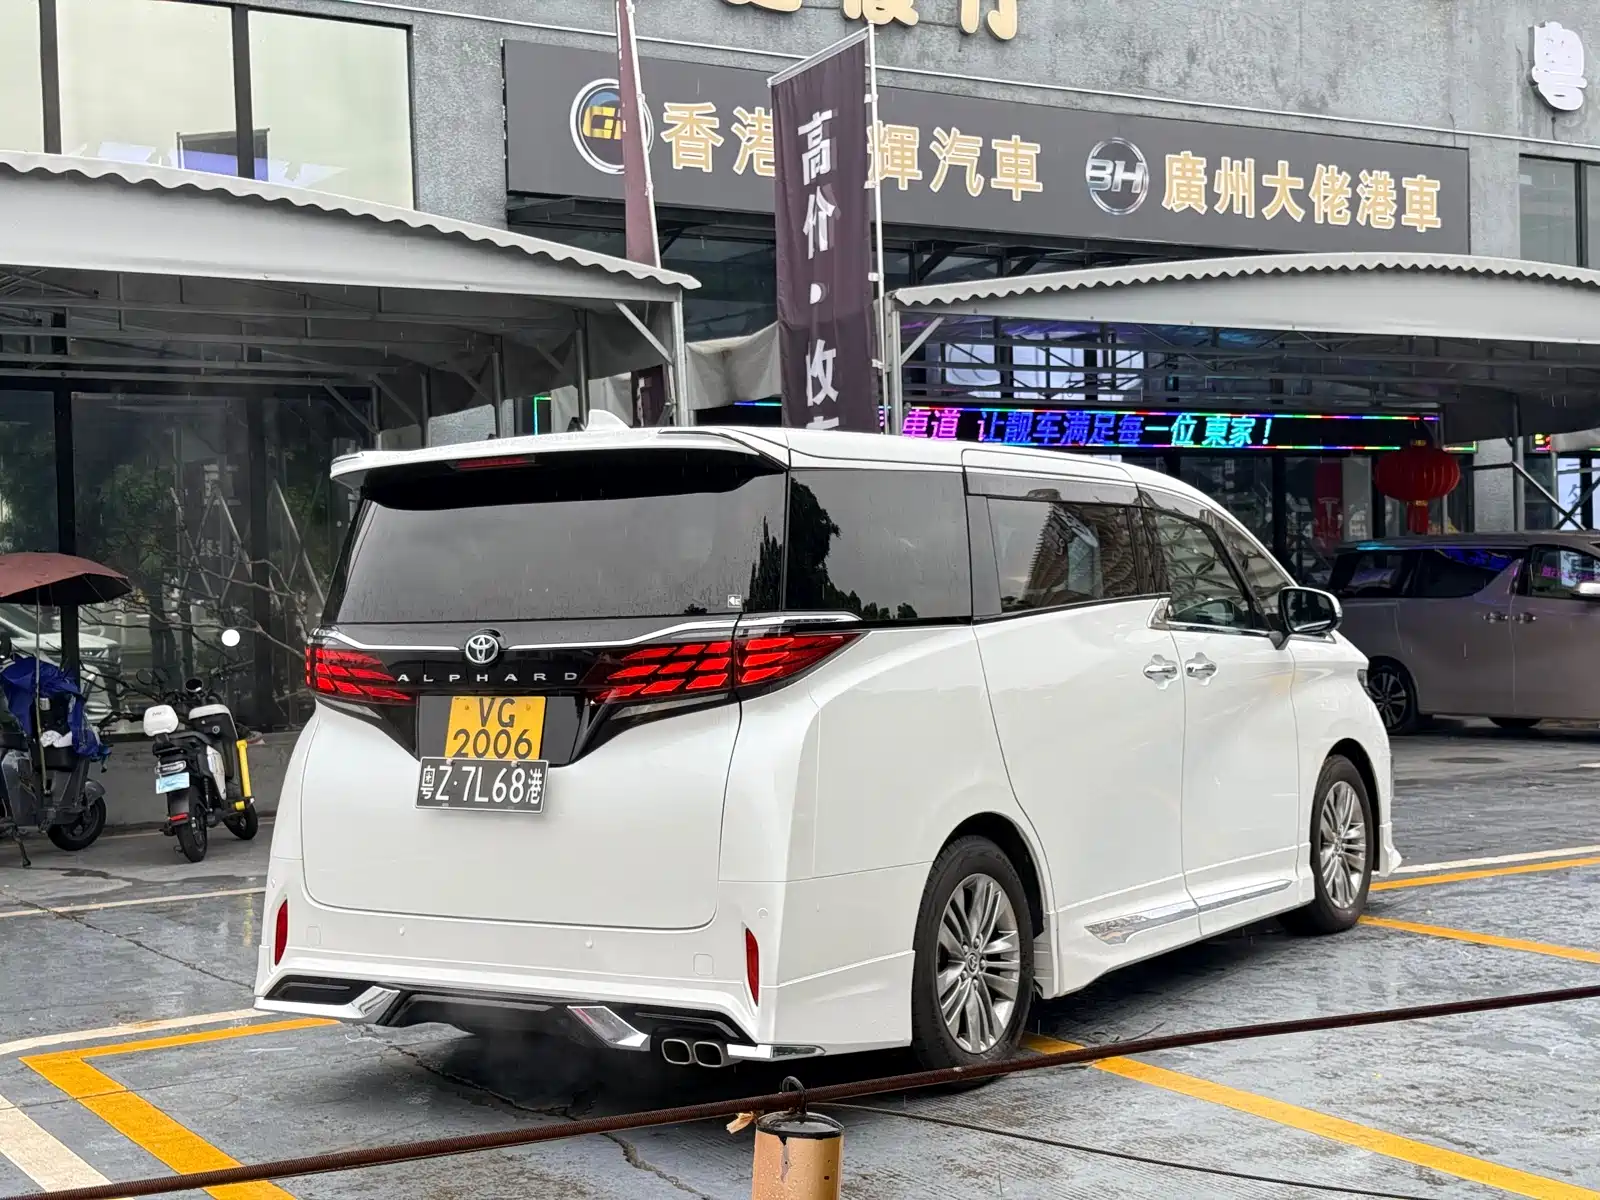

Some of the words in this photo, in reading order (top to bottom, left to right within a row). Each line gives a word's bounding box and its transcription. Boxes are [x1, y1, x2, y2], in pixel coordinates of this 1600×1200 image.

[660, 101, 1043, 202] 香港輝汽車
[1162, 150, 1442, 233] 廣州大佬港車
[397, 672, 578, 683] ALPHARD
[478, 697, 517, 728] VG
[452, 728, 533, 759] 2006
[420, 765, 543, 805] 粤Z·7L68港
